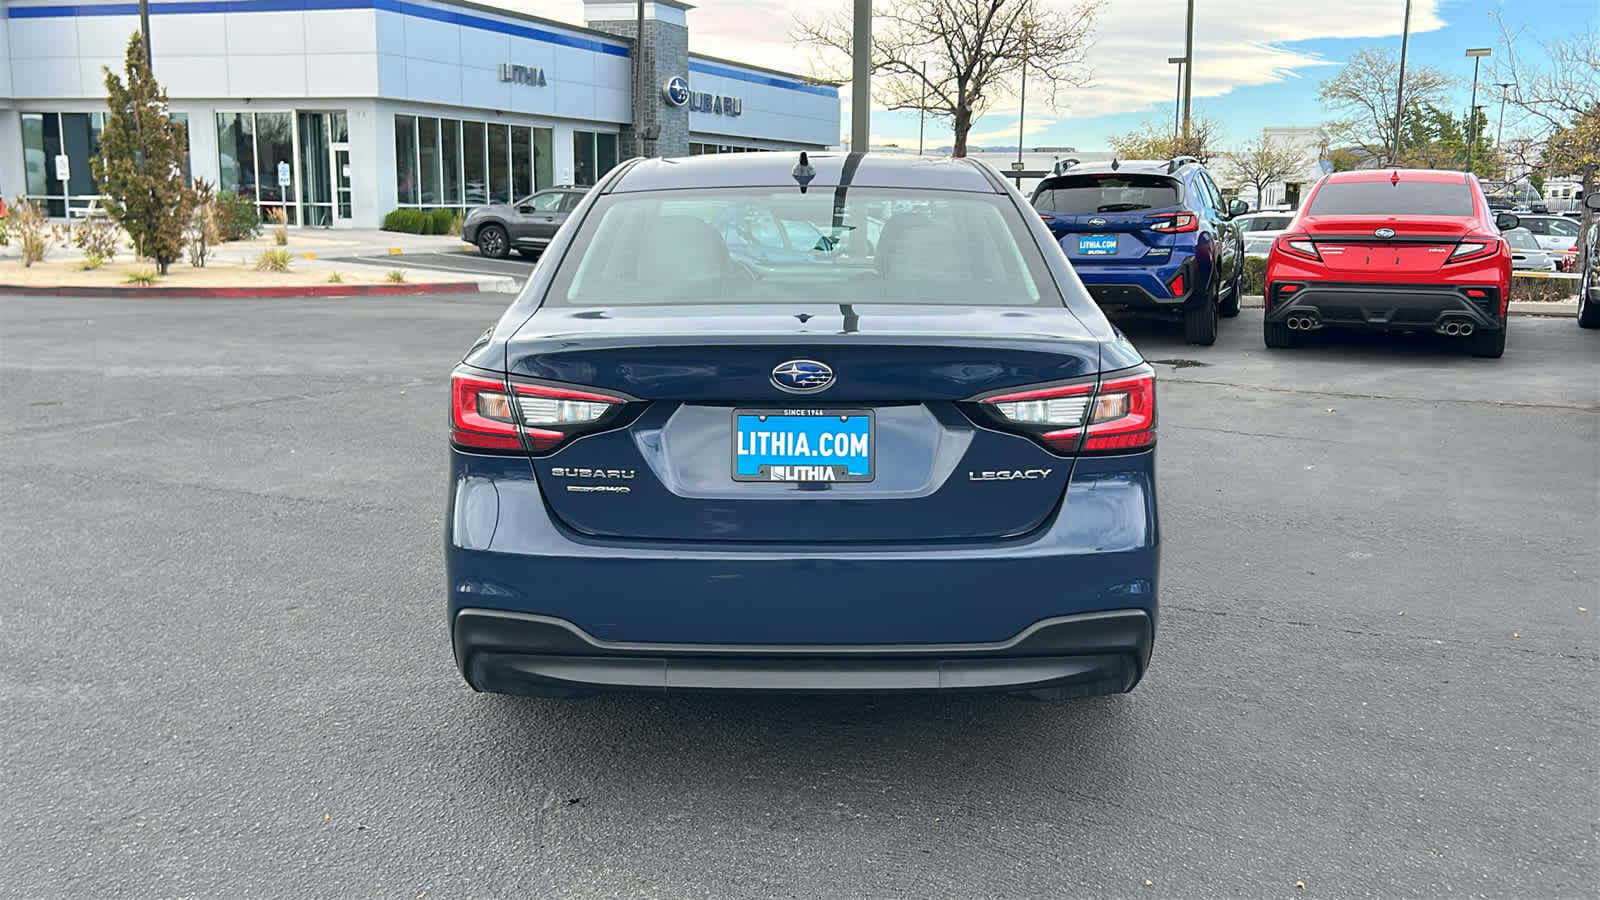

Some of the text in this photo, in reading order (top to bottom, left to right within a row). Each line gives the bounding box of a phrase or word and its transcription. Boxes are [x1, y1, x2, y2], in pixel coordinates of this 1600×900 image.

[499, 64, 547, 87] LITHIA
[1080, 240, 1117, 249] LITHIA.COM
[737, 431, 869, 457] LITHIA.COM
[551, 467, 635, 479] SUBARU
[785, 466, 836, 481] LITHIA
[968, 469, 1052, 480] LEGACY
